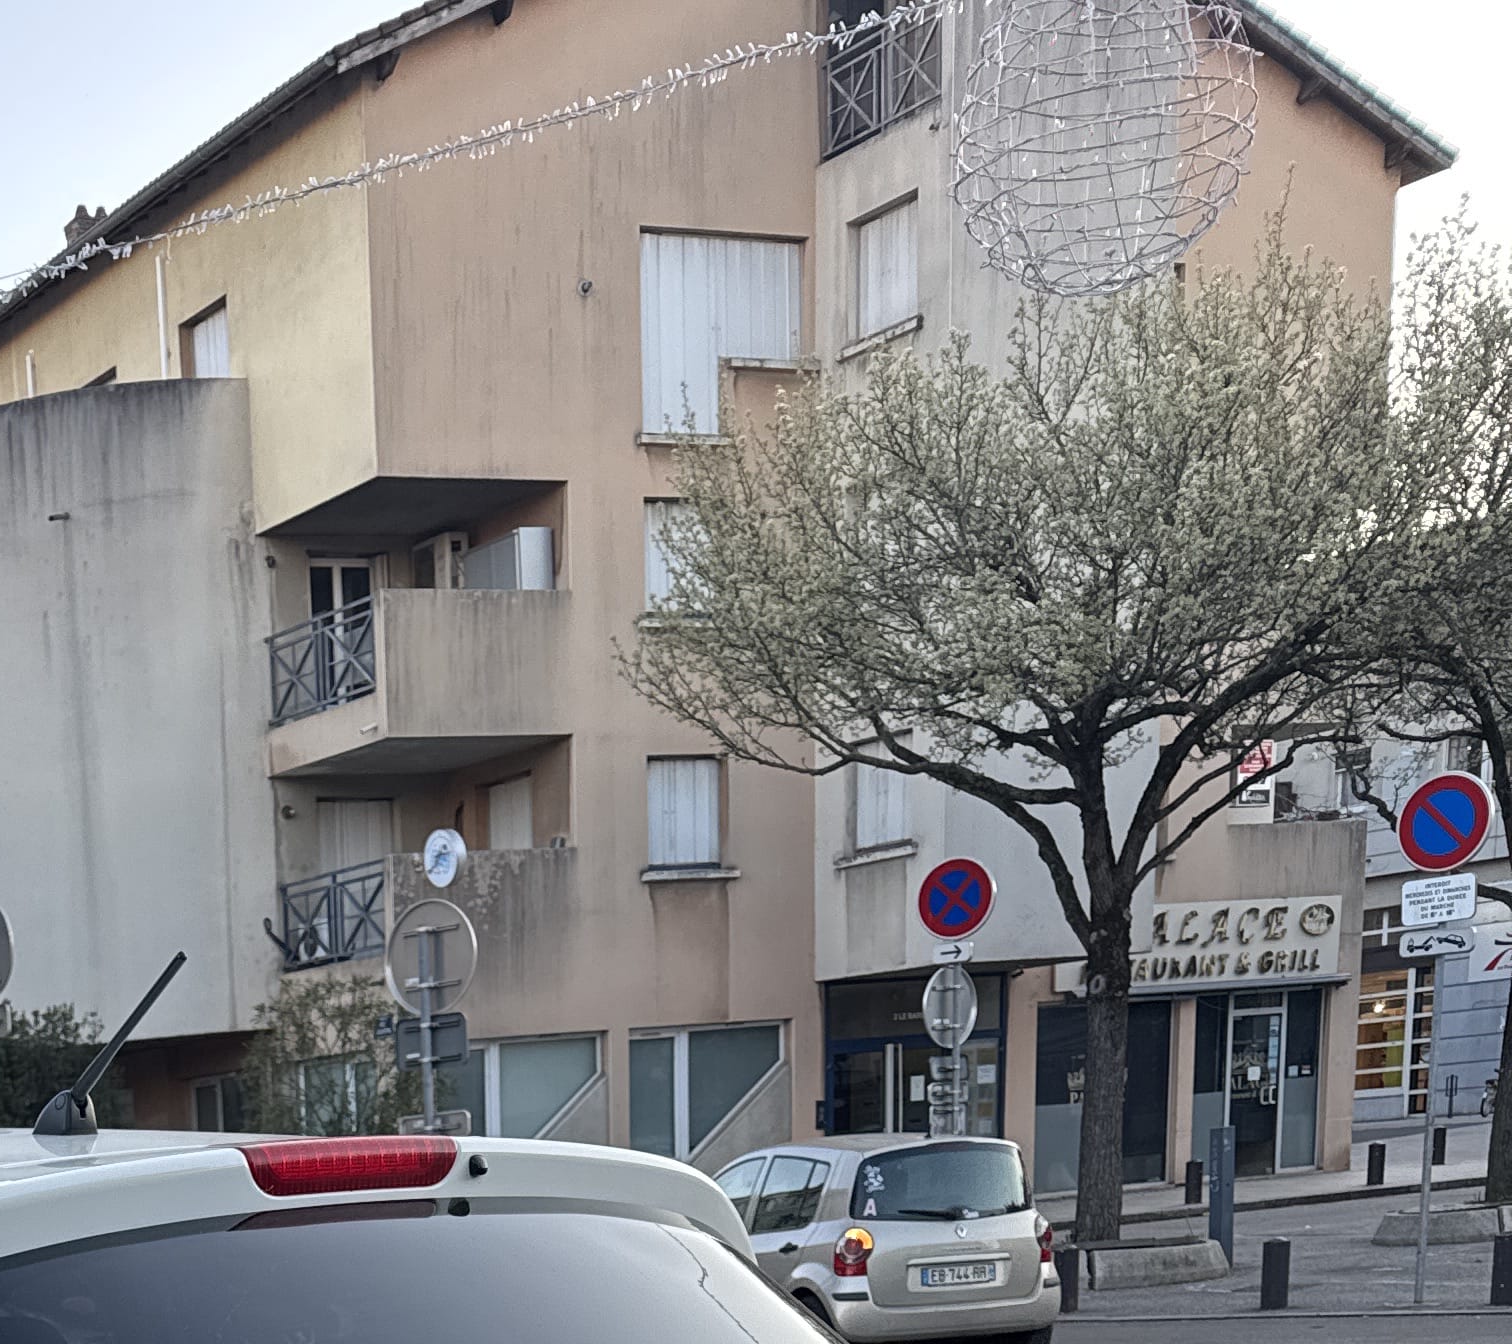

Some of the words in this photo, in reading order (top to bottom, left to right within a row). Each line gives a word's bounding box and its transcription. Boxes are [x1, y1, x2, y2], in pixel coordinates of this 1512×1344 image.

[1409, 897, 1435, 906] PENDANT
[1437, 895, 1445, 903] LA
[1153, 905, 1289, 949] ALACE
[1257, 949, 1320, 974] GRILL
[863, 1198, 877, 1216] A
